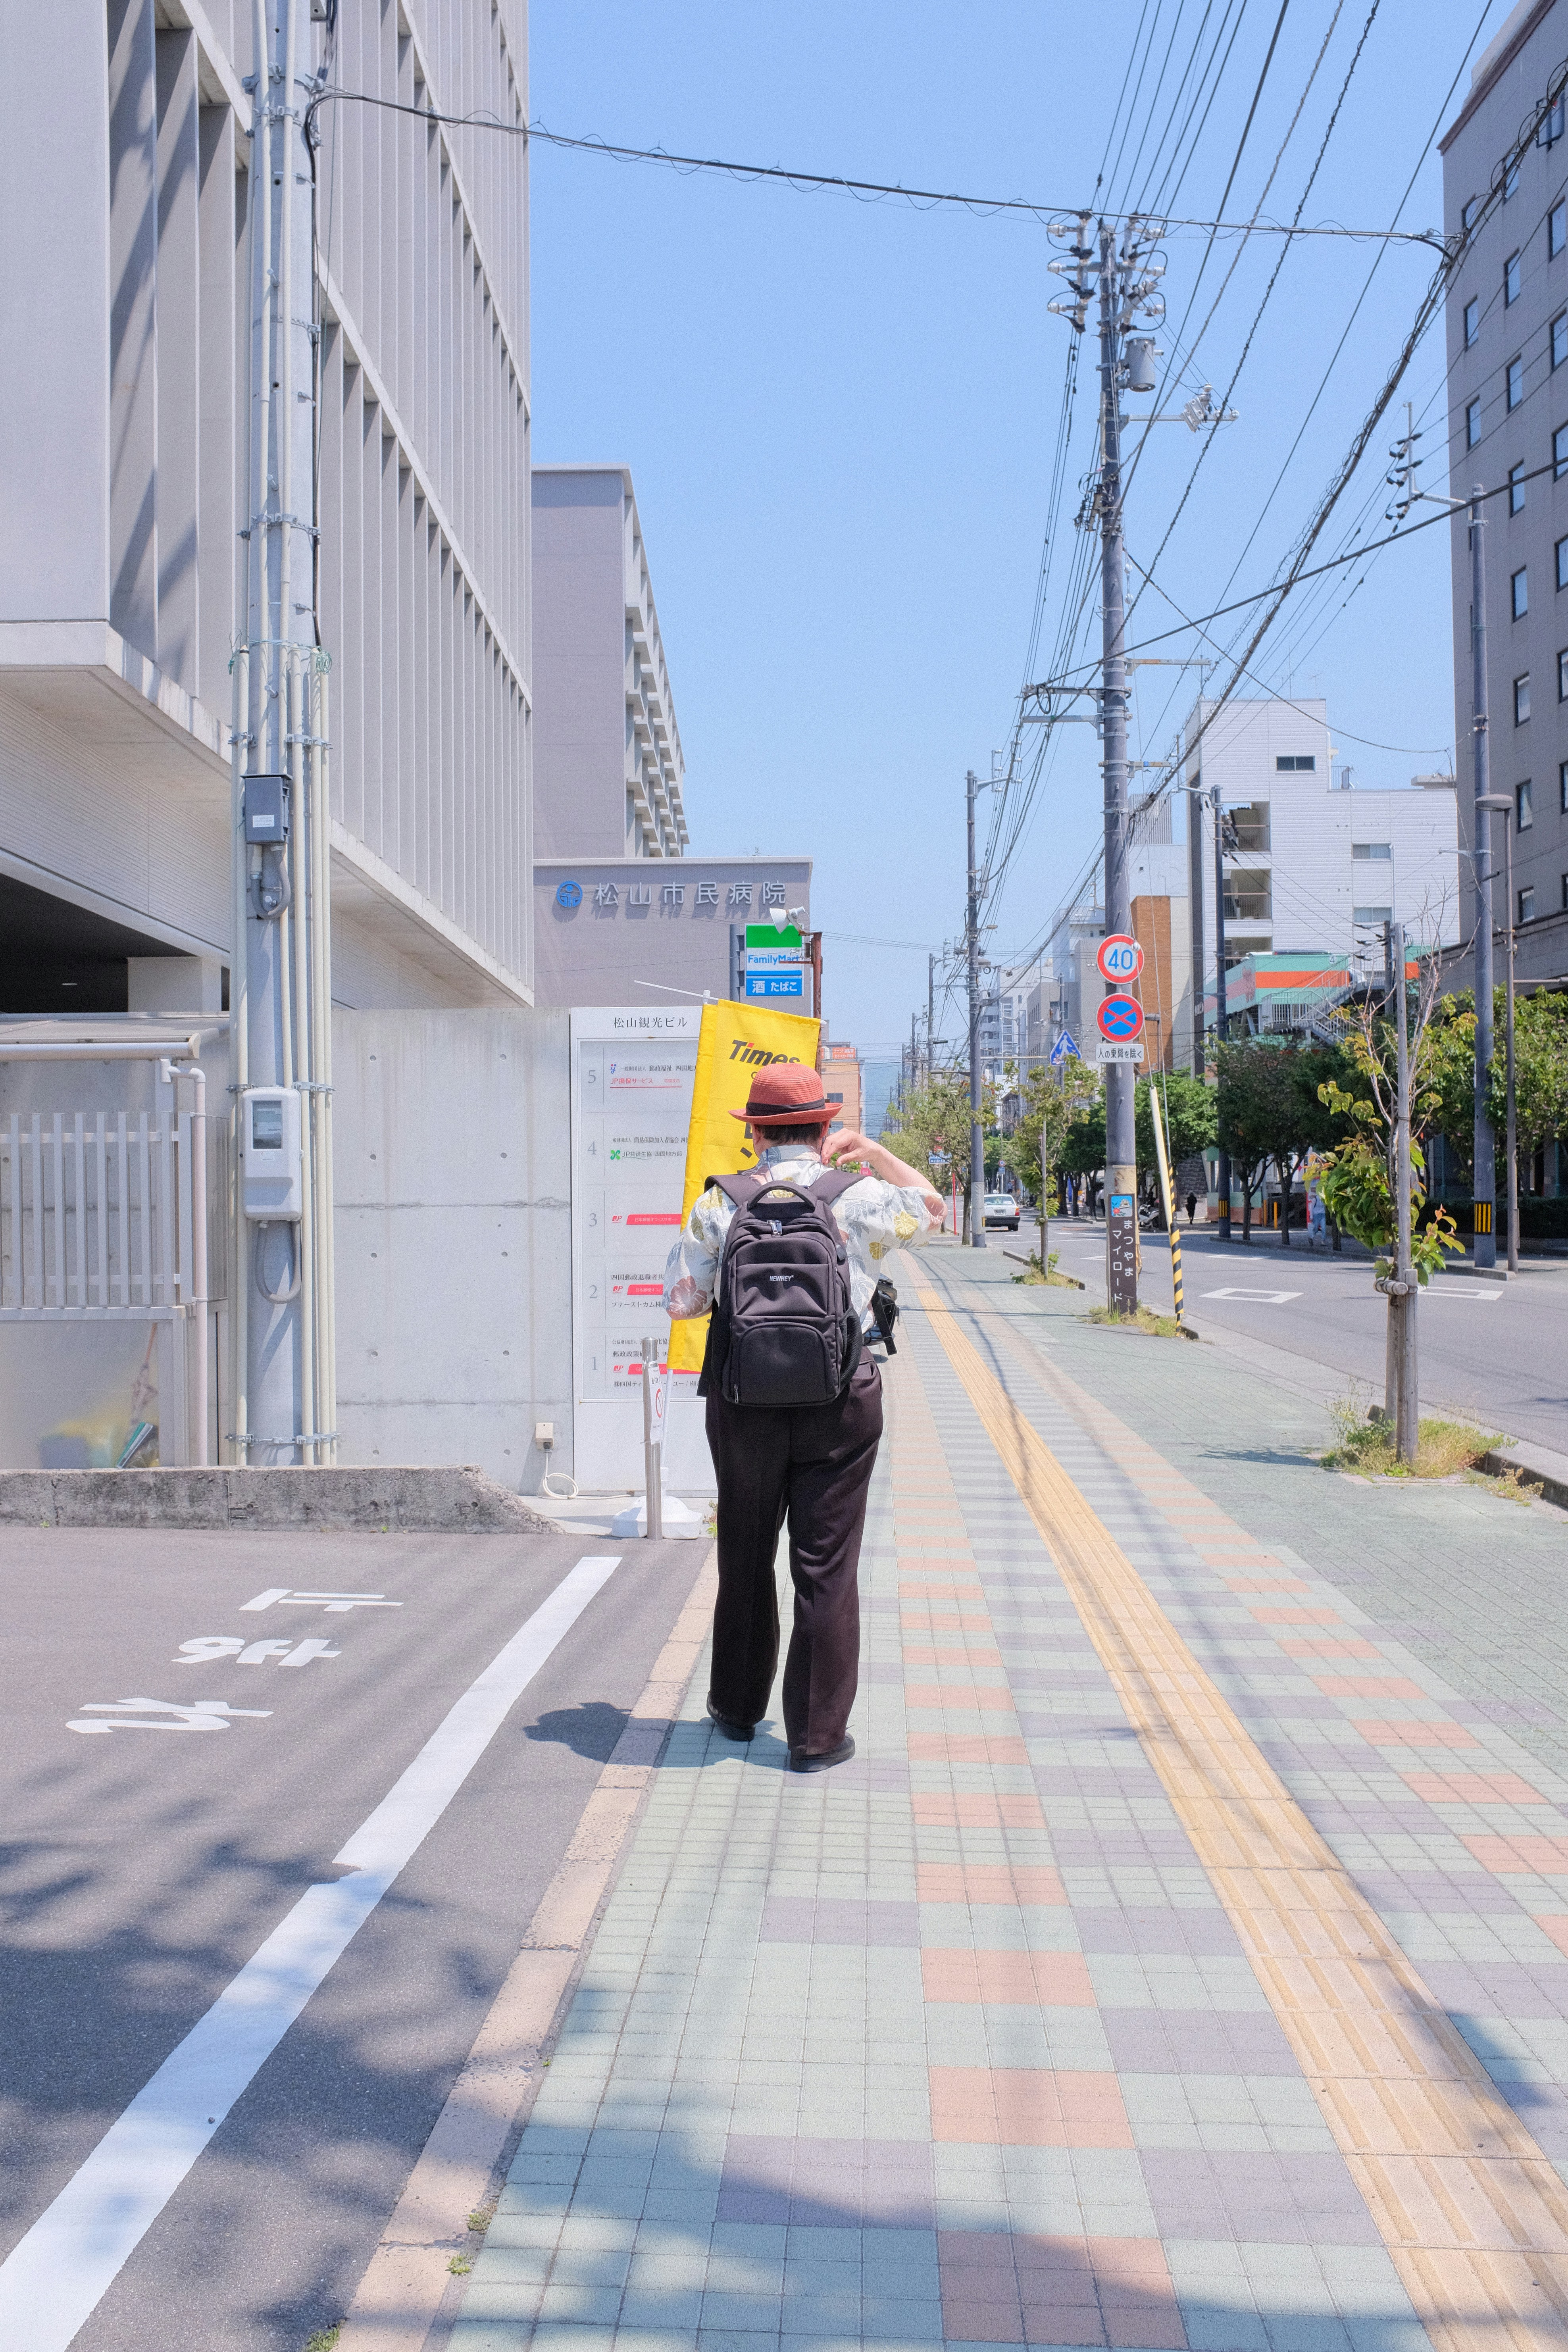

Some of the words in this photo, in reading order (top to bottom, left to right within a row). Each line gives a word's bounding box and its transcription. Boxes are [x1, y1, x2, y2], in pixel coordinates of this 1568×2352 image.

[595, 880, 786, 906] 松山市民病院
[748, 955, 800, 965] FamilyMart
[1108, 949, 1133, 969] 40
[752, 981, 765, 993] 酒
[771, 981, 797, 992] たばこ
[613, 1017, 687, 1028] 松山観光ビル
[1098, 1048, 1142, 1059] 人の乗降を除く
[588, 1070, 596, 1084] 5
[588, 1141, 597, 1155] 4
[589, 1213, 597, 1227] 3
[1124, 1220, 1133, 1277] まつやま
[1112, 1230, 1122, 1302] マイロード
[589, 1285, 598, 1299] 2
[592, 1357, 597, 1370] 1
